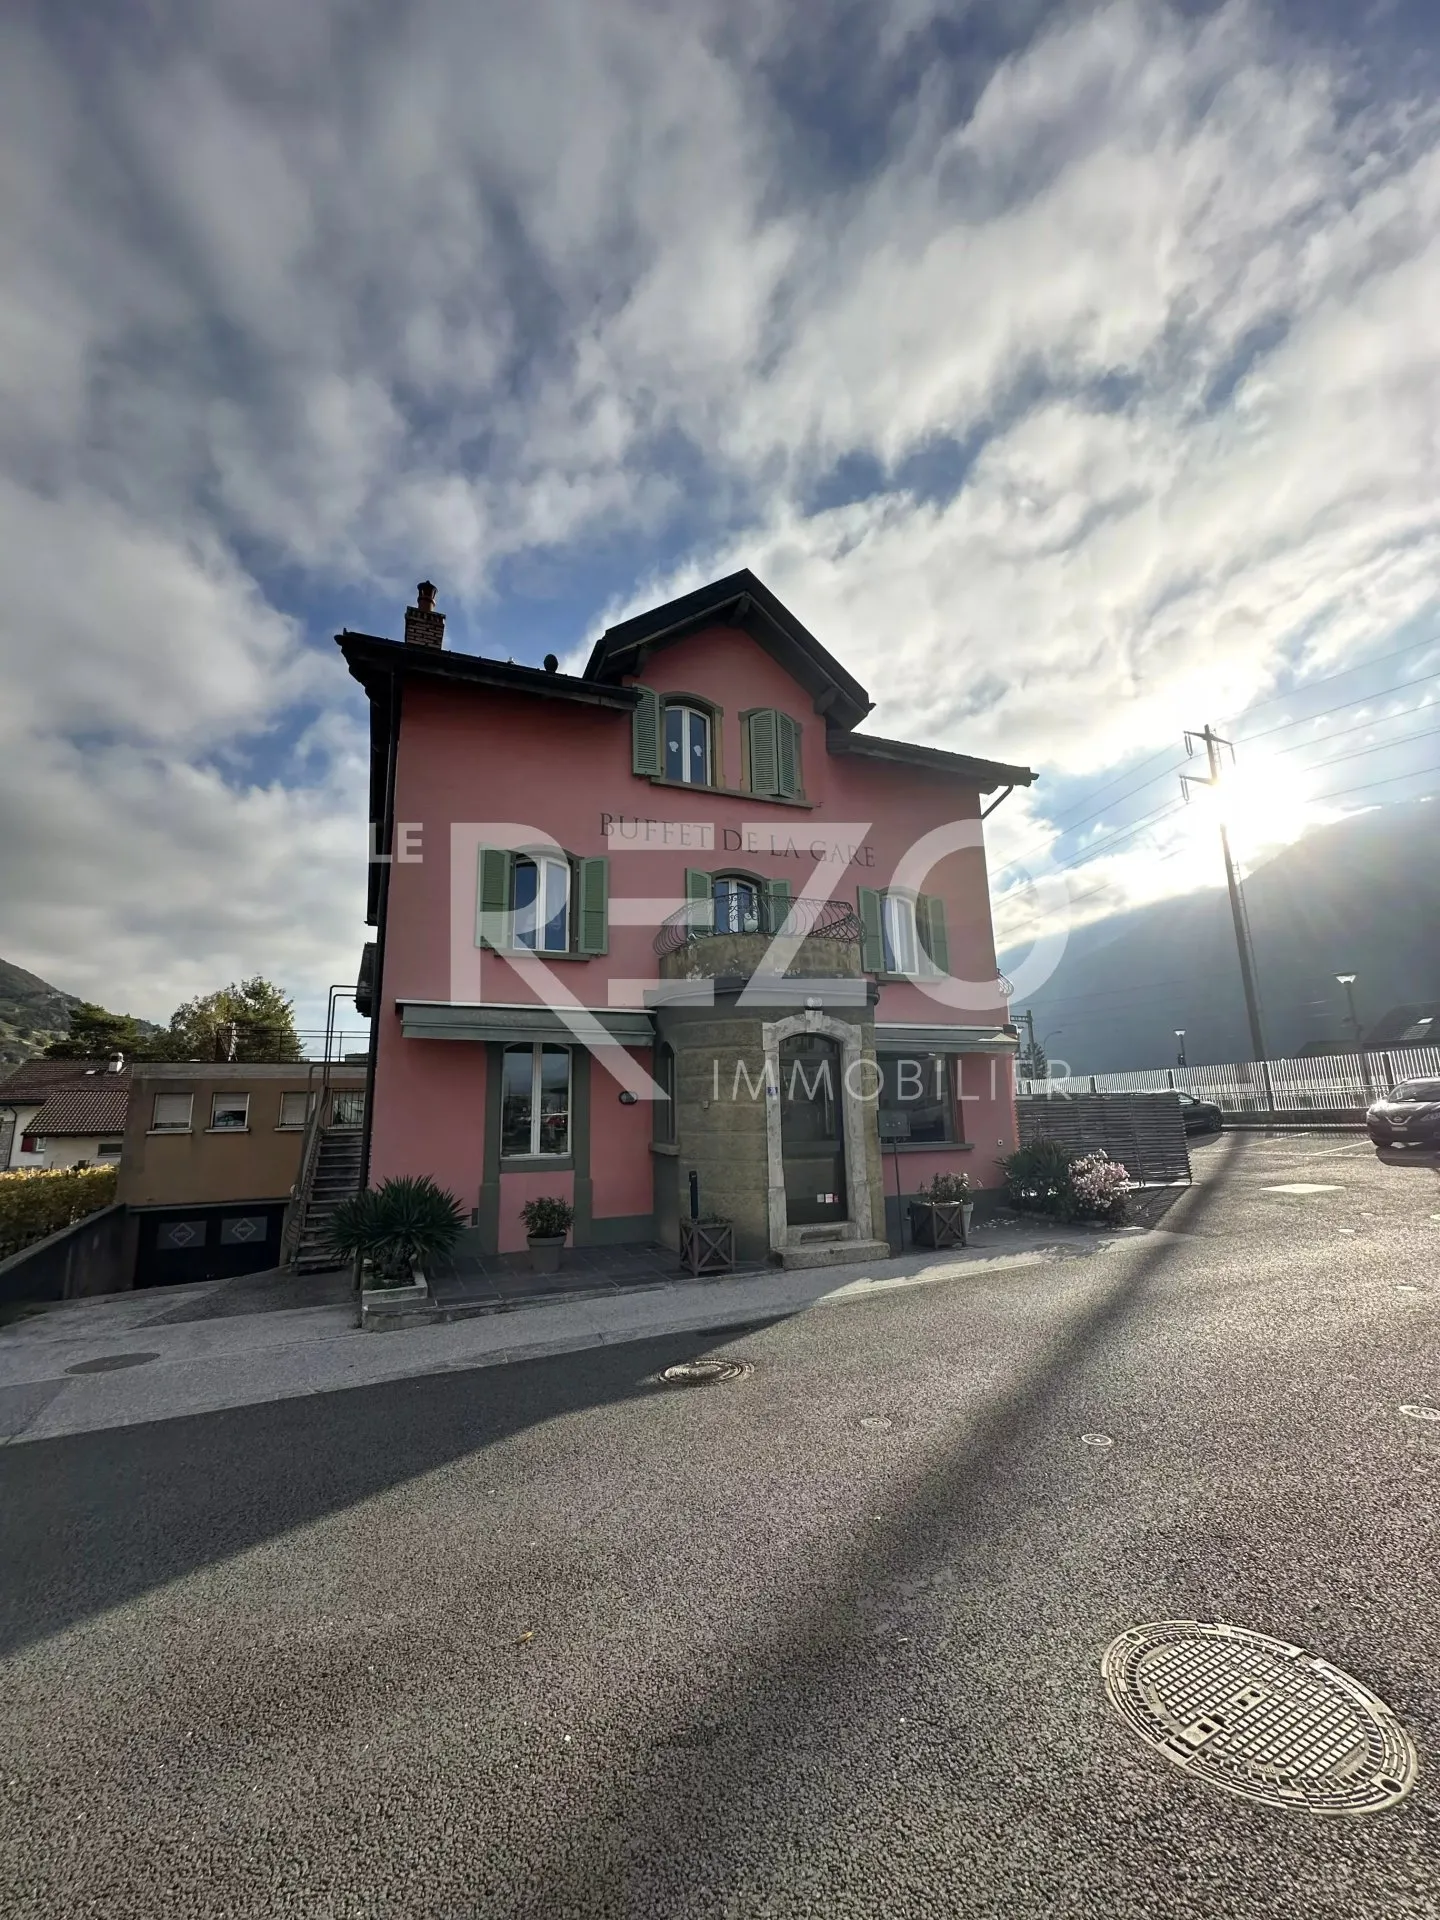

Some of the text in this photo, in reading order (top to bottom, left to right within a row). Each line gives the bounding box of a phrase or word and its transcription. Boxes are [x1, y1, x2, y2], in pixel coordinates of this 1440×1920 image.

[600, 813, 876, 868] BUFFET DE LA GARE
